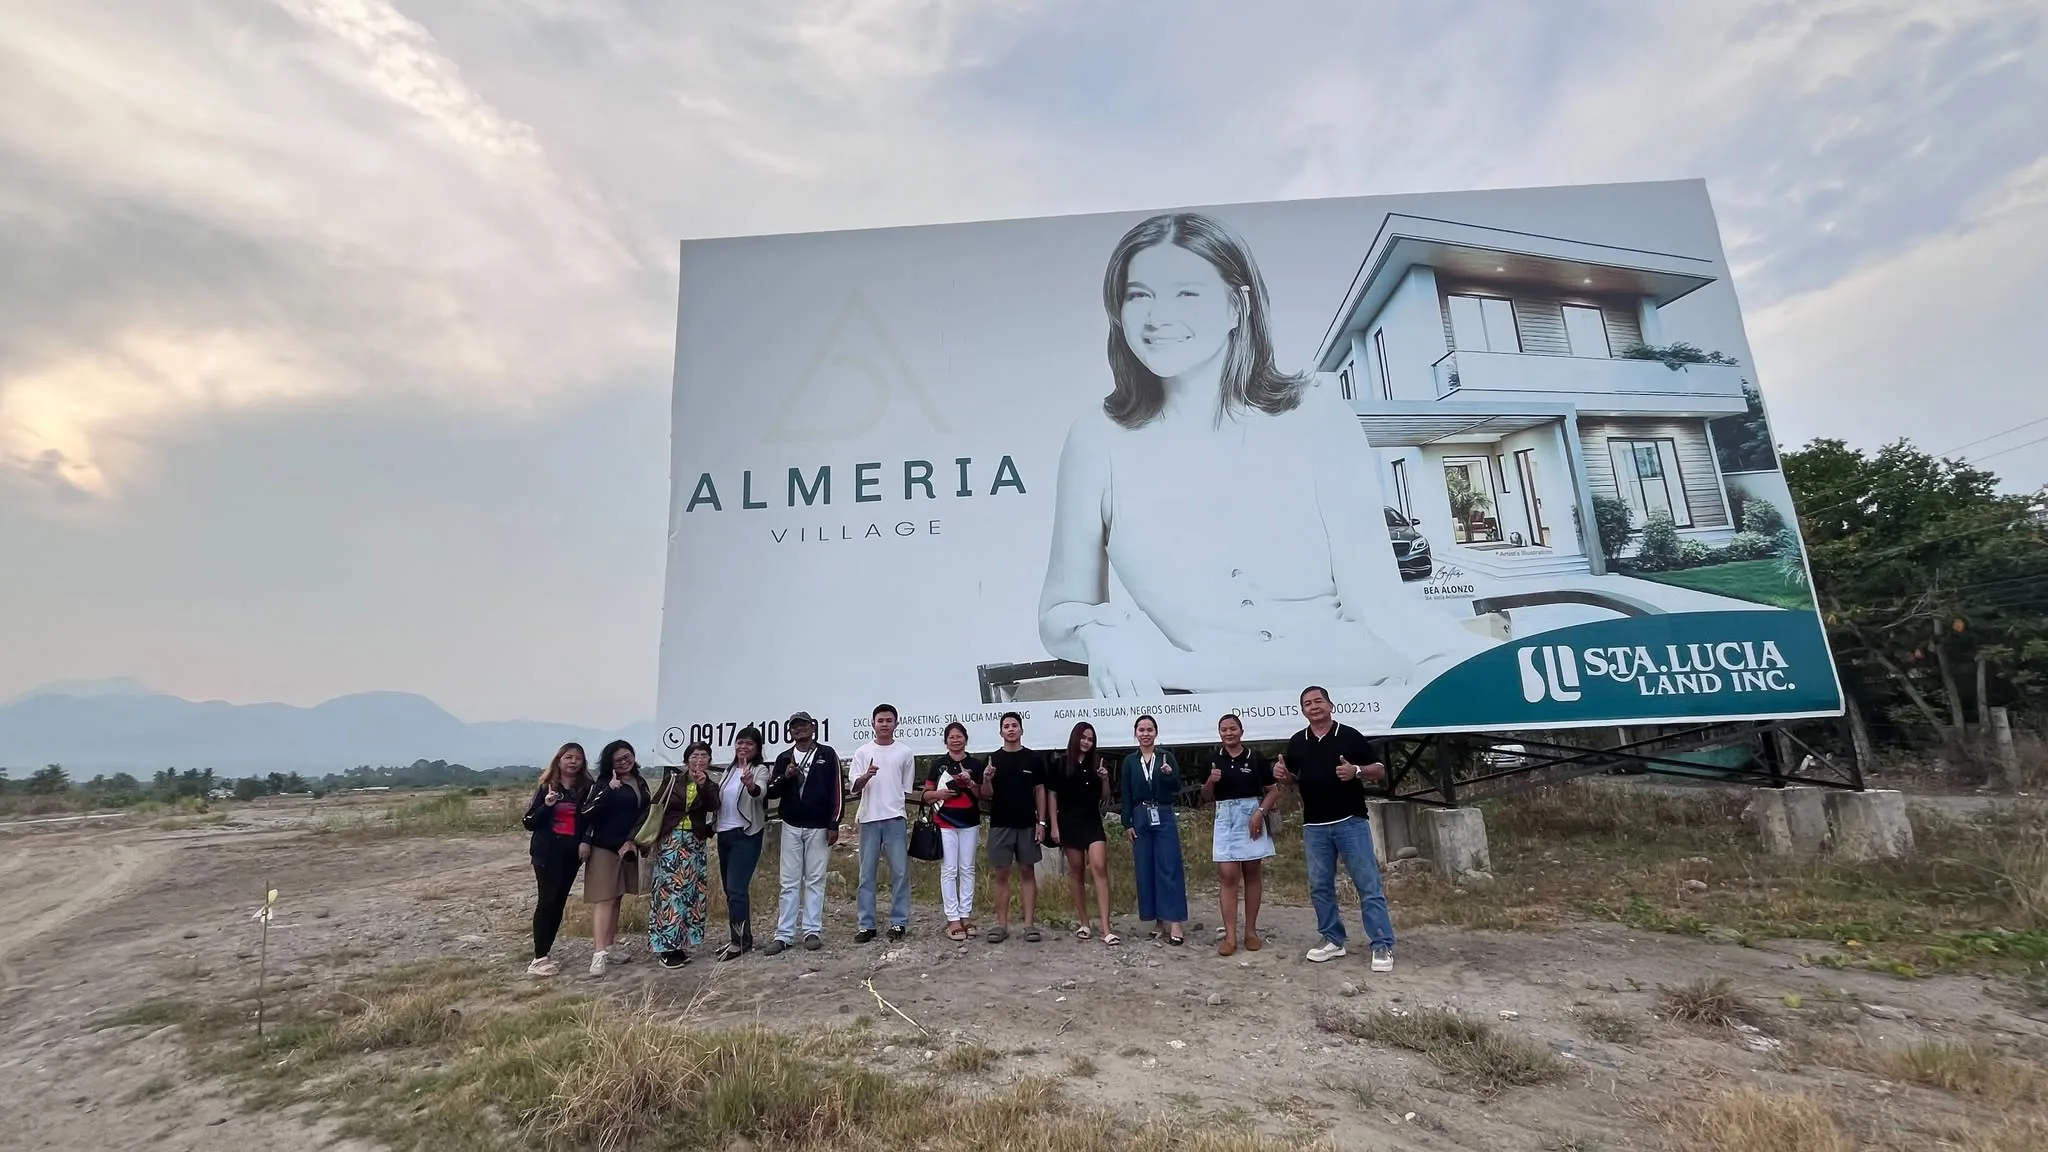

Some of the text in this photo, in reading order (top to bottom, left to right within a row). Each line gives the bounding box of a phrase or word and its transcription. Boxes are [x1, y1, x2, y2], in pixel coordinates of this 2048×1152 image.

[685, 455, 1027, 513] ALMERIA
[771, 519, 941, 543] VILLAGE
[1423, 584, 1475, 595] BEA ALONZO
[1637, 669, 1796, 696] LAND INC.
[1130, 705, 1163, 716] NEGROS
[1164, 703, 1202, 714] ORIENTAL
[1231, 706, 1276, 718] DHSUD
[1279, 705, 1299, 716] LTS
[961, 713, 984, 723] LUCIA
[690, 722, 737, 747] 0917
[853, 730, 870, 740] COR
